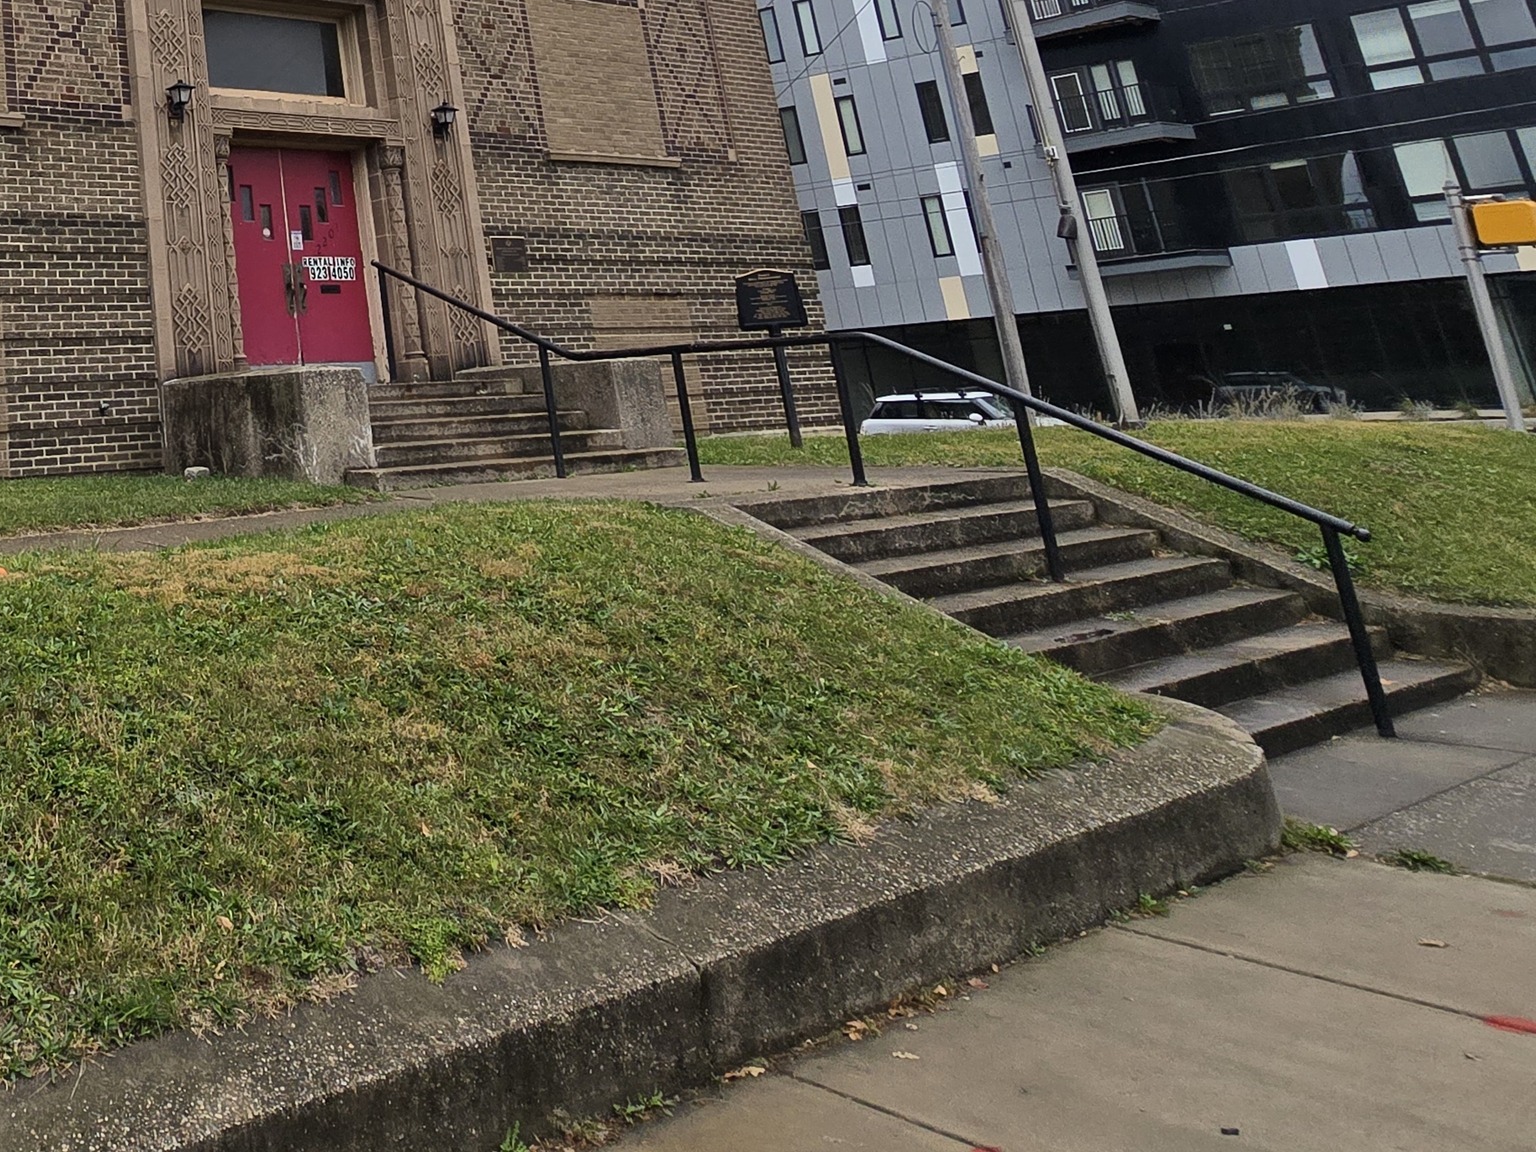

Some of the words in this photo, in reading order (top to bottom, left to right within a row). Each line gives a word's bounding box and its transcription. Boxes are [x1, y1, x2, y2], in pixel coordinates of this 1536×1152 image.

[303, 257, 333, 266] RENTAL
[336, 257, 355, 266] INFO
[311, 267, 328, 279] 923
[332, 267, 355, 279] 4050
